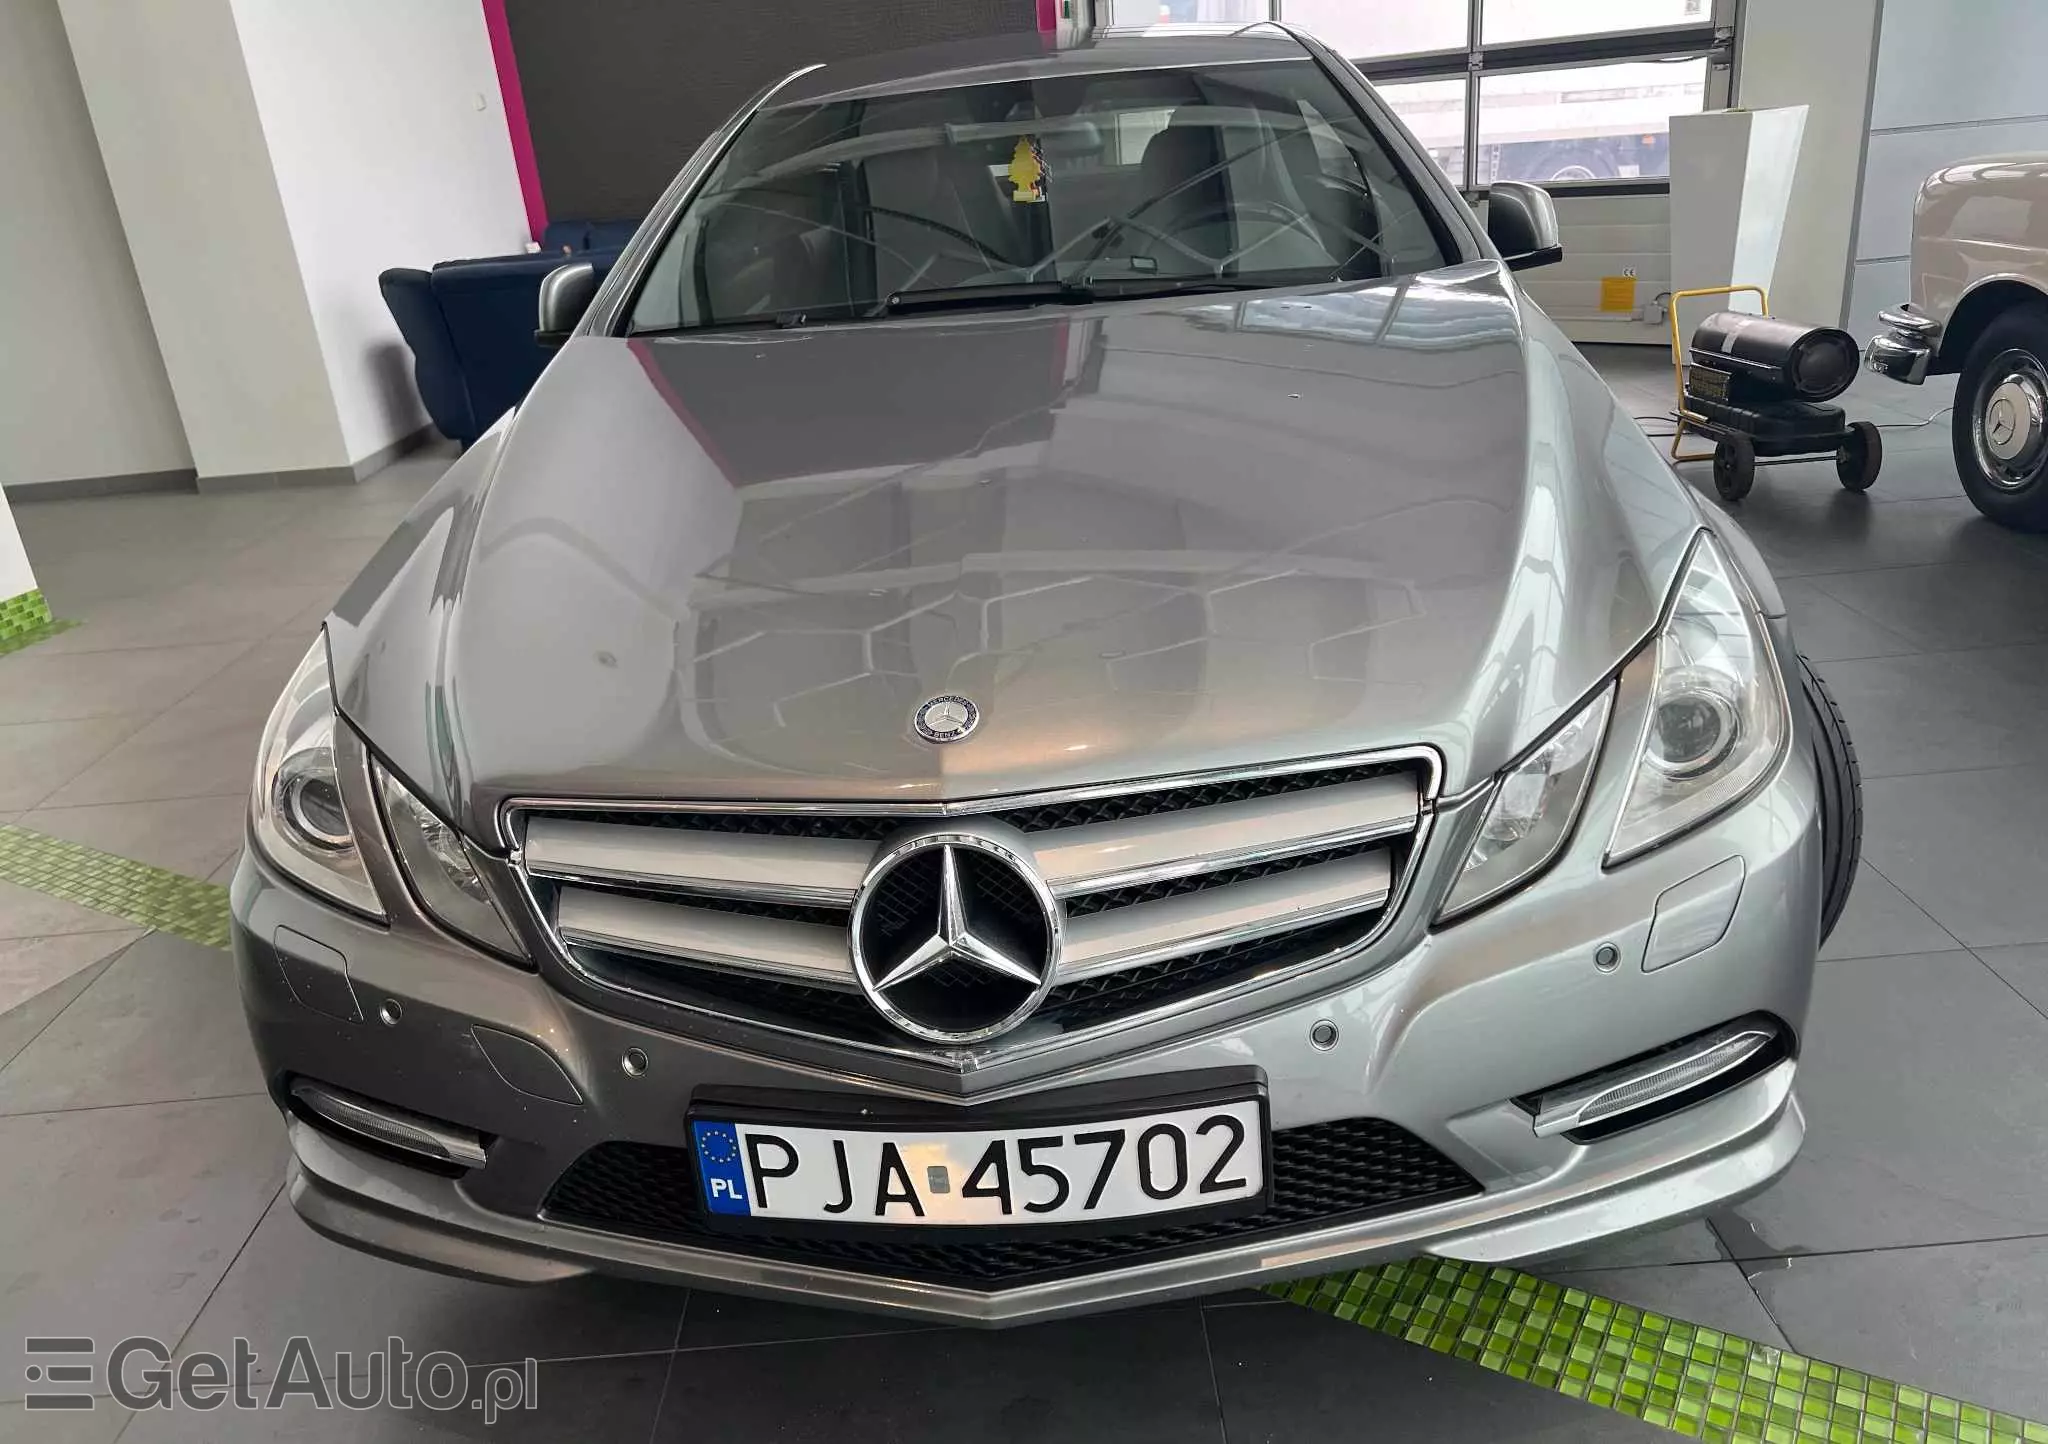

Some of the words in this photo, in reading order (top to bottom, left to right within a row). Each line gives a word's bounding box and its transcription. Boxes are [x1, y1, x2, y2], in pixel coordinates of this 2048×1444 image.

[711, 1178, 742, 1199] PL
[745, 1133, 925, 1217] PJA
[961, 1114, 1247, 1216] 45702
